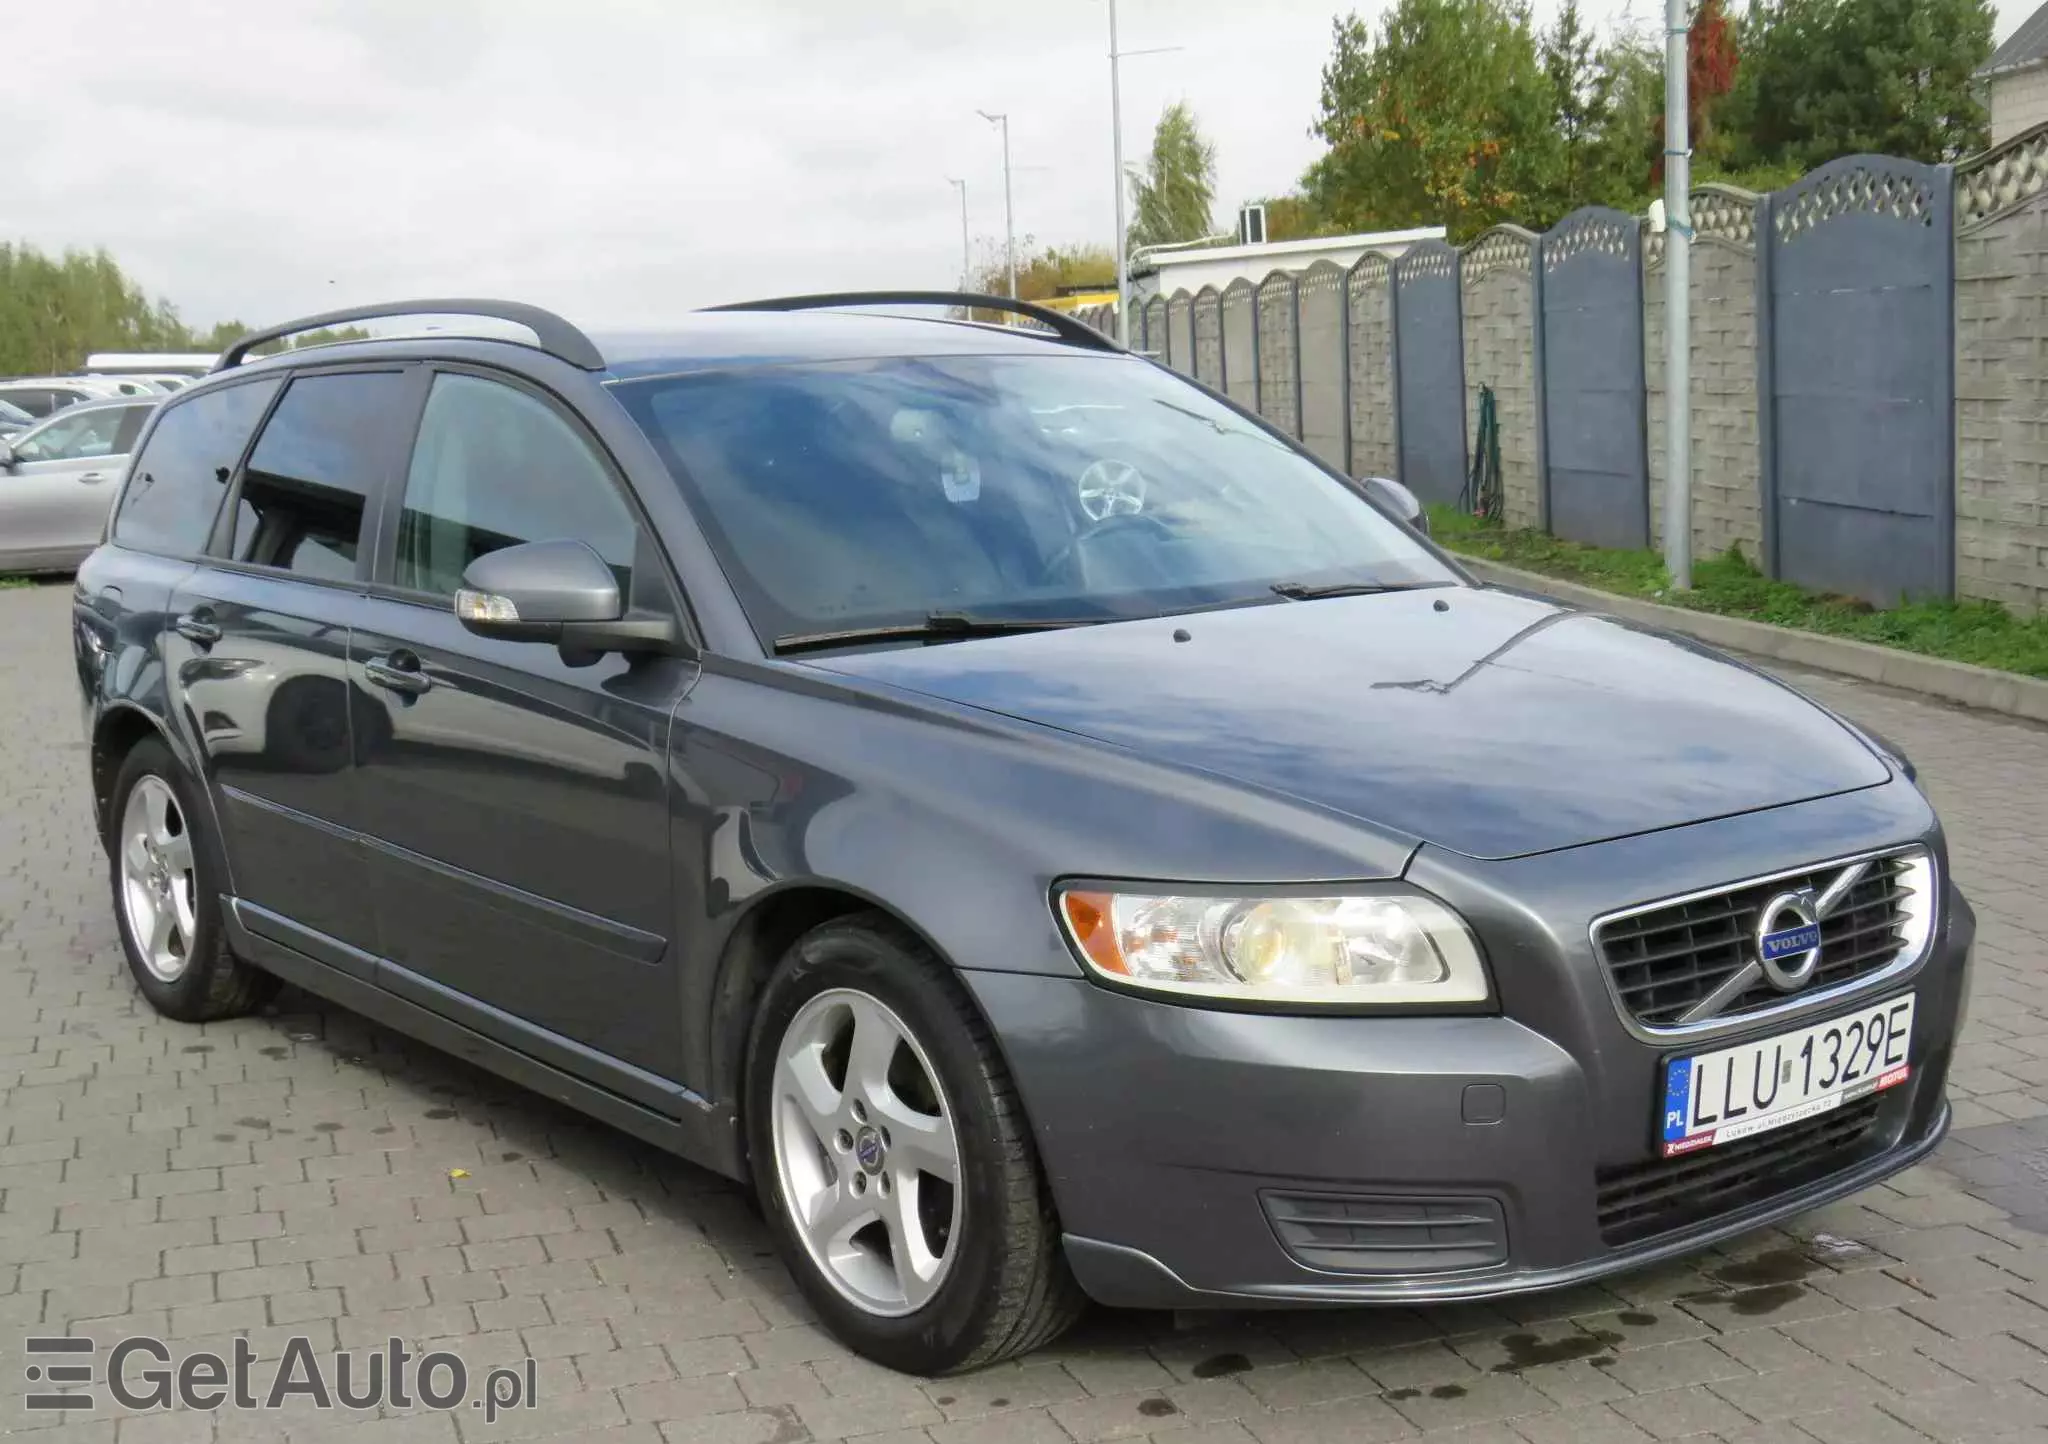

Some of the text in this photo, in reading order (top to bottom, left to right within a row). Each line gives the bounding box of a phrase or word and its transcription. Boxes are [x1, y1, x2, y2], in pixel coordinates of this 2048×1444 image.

[1767, 931, 1818, 953] VOLVO
[1693, 1003, 1909, 1128] LLU 1329E
[1667, 1111, 1684, 1129] PL
